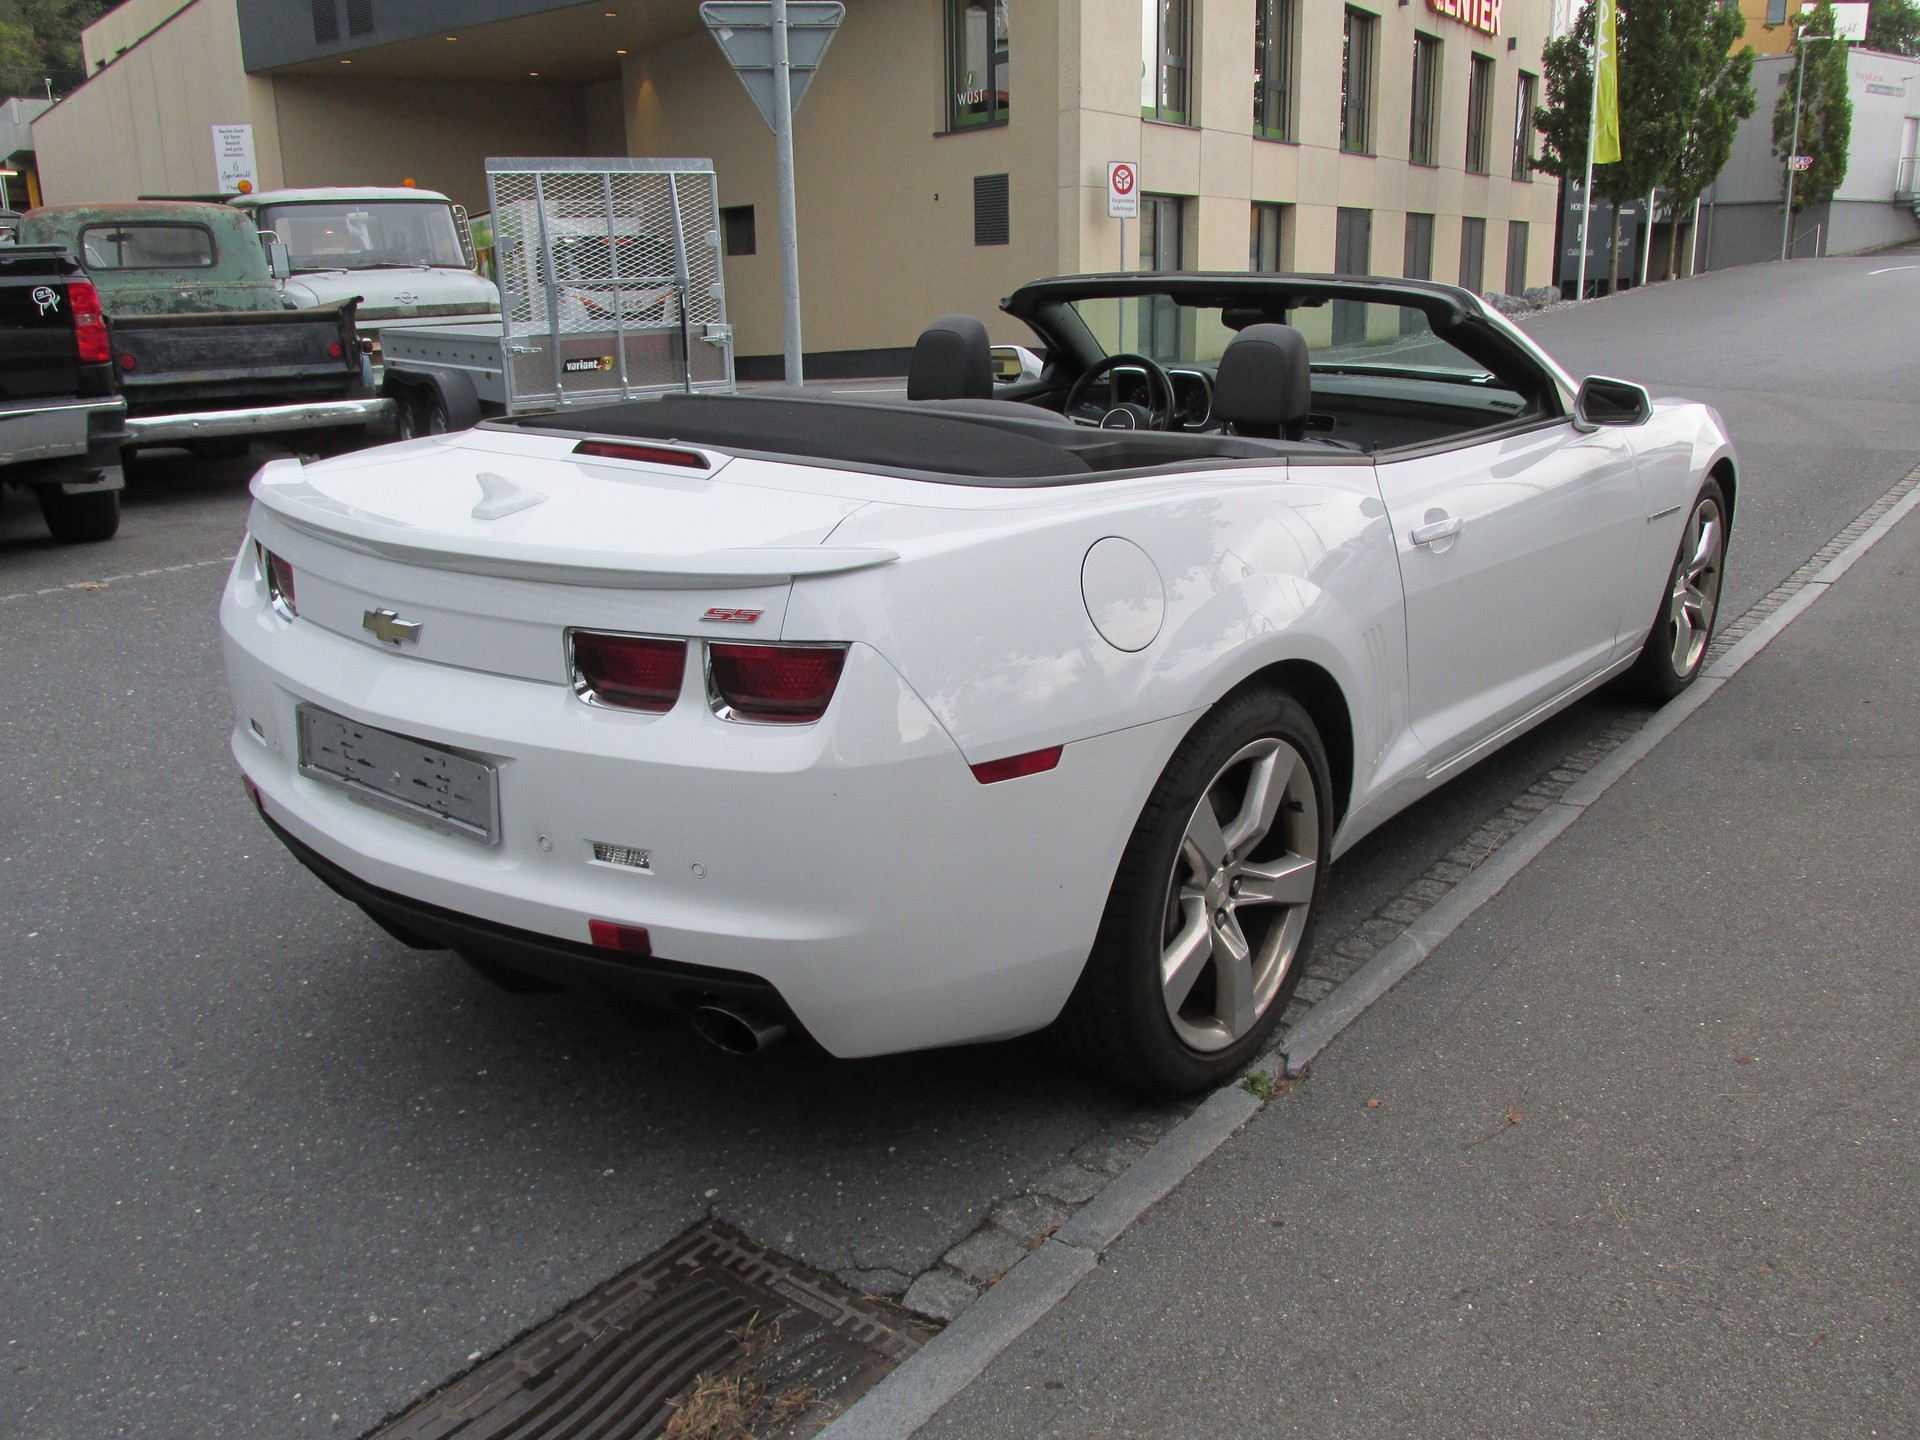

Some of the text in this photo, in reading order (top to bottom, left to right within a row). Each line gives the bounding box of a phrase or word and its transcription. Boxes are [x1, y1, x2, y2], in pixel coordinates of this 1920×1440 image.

[1433, 0, 1503, 36] NTER
[566, 359, 599, 371] variant
[699, 607, 765, 624] SS
